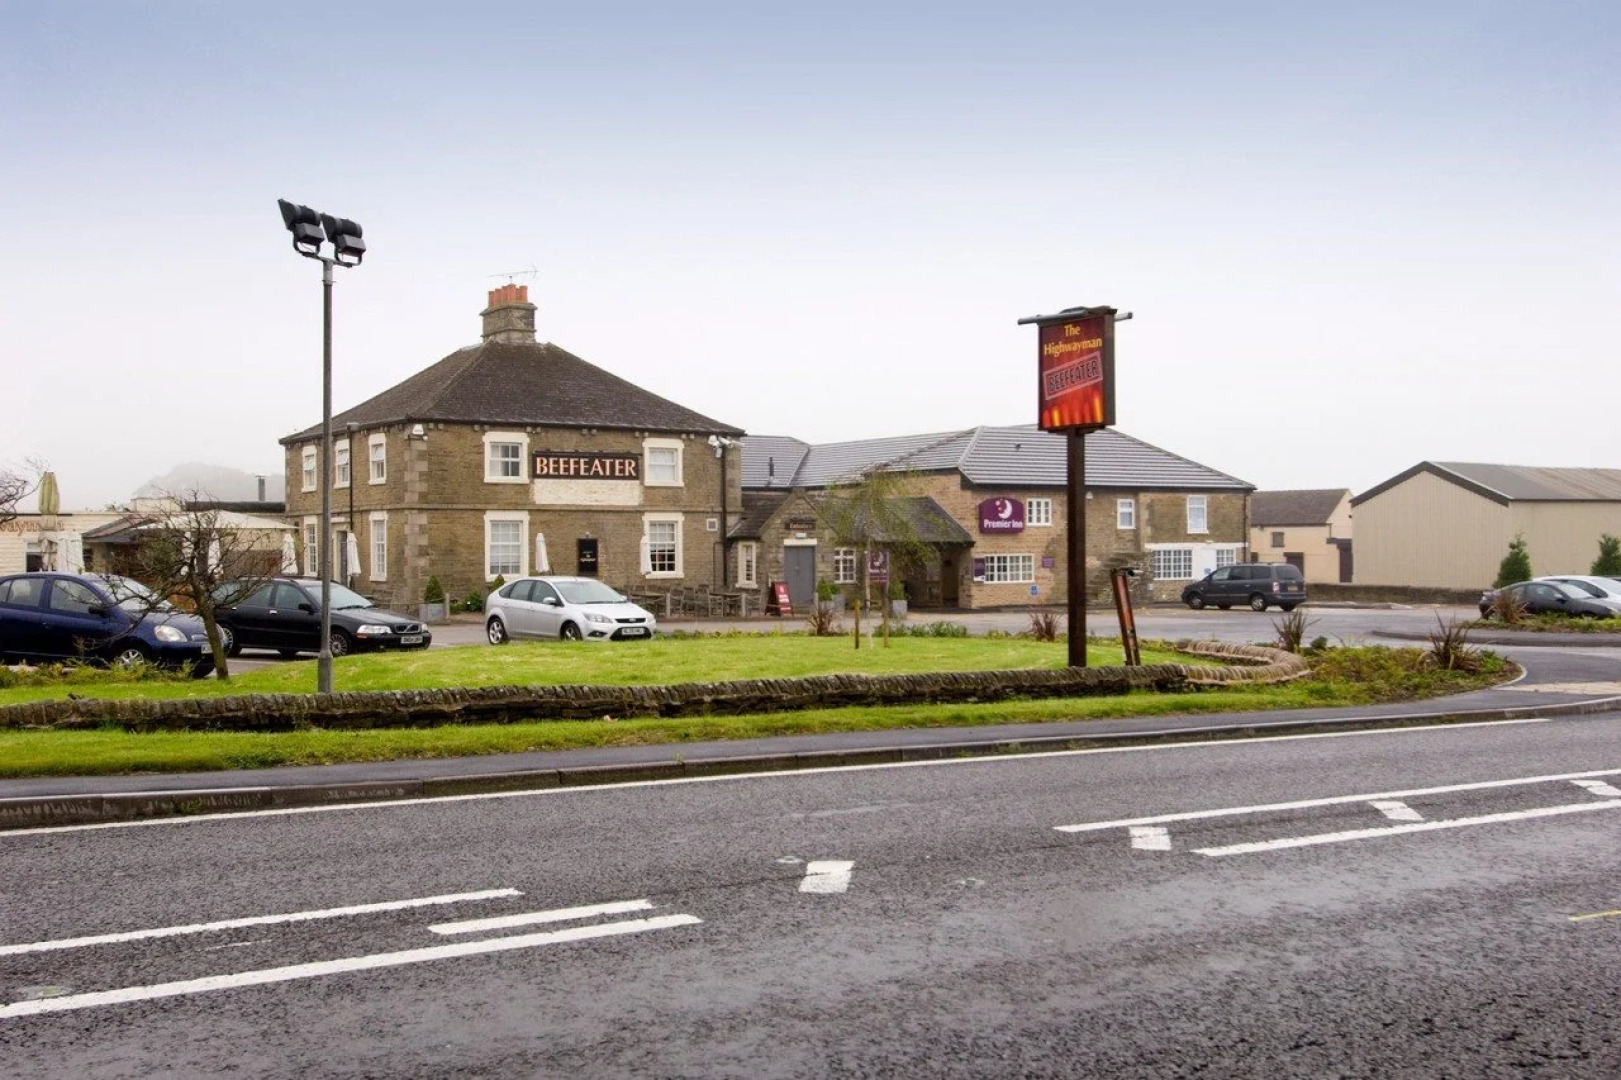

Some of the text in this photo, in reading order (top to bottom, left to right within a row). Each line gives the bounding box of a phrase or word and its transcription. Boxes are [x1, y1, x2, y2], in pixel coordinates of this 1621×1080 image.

[1063, 324, 1081, 337] The
[1043, 338, 1103, 358] Highwayman
[1048, 360, 1099, 393] BEEFEATER
[536, 456, 637, 477] BEEFEATER
[983, 518, 1024, 529] Premier Inn
